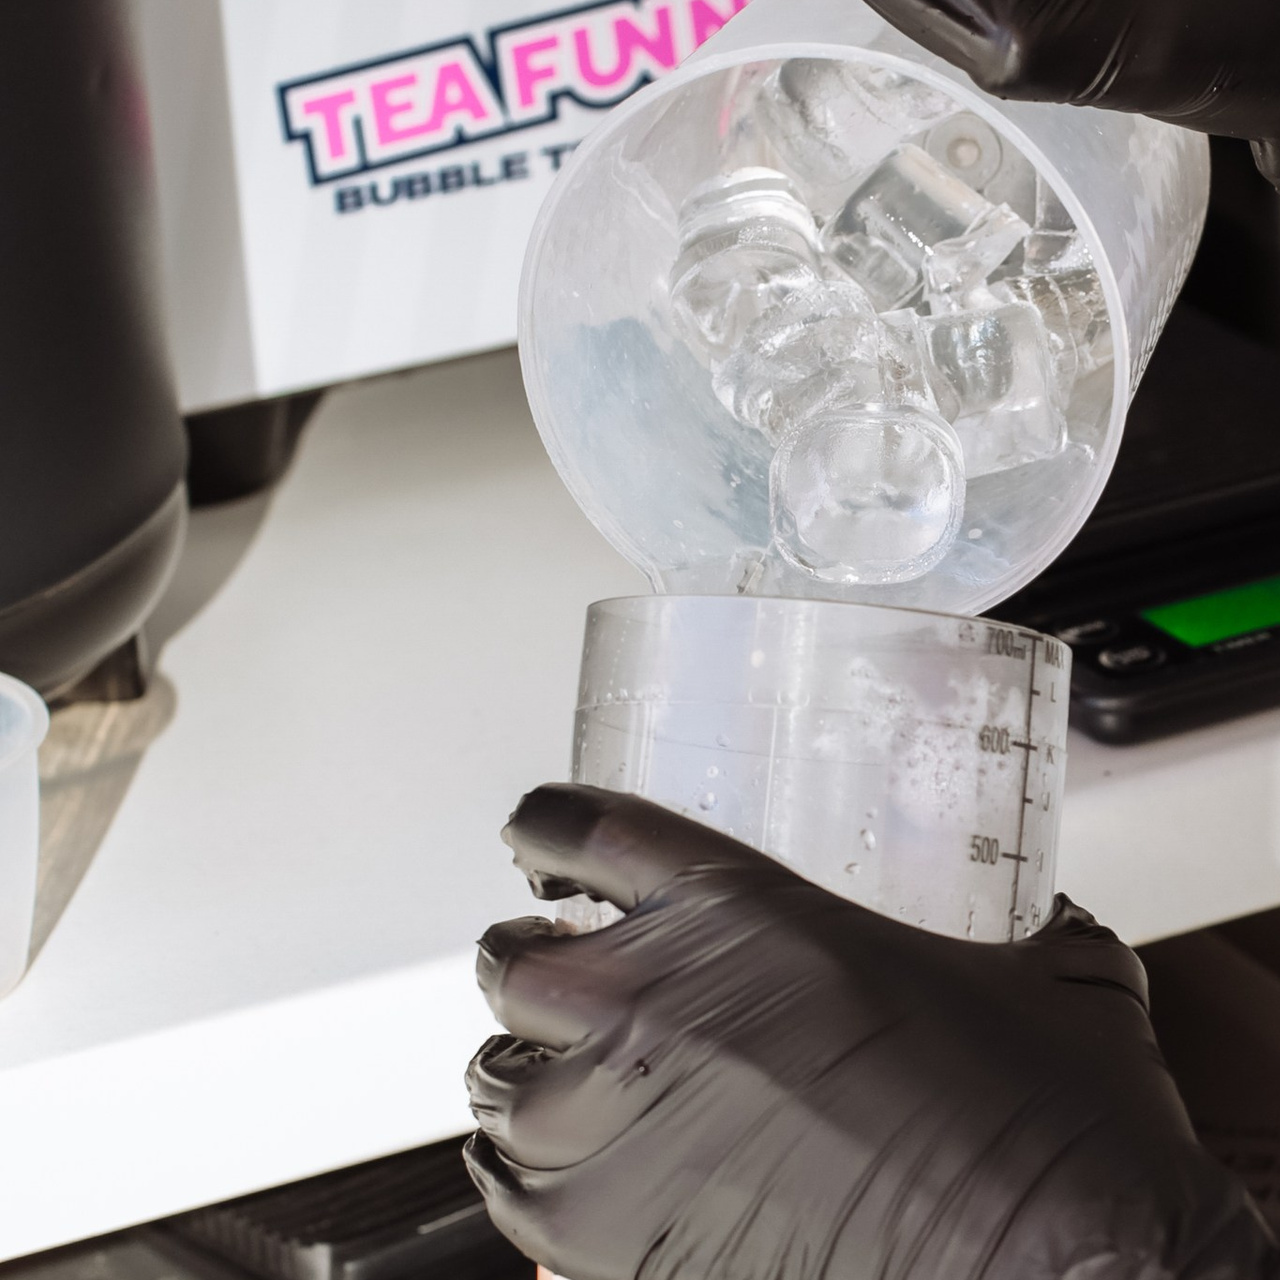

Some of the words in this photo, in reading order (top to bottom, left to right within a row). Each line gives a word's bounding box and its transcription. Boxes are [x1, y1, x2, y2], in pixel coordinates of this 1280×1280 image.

[303, 60, 489, 161] TEA
[335, 147, 531, 214] BUBBLE
[969, 834, 1000, 866] 500
